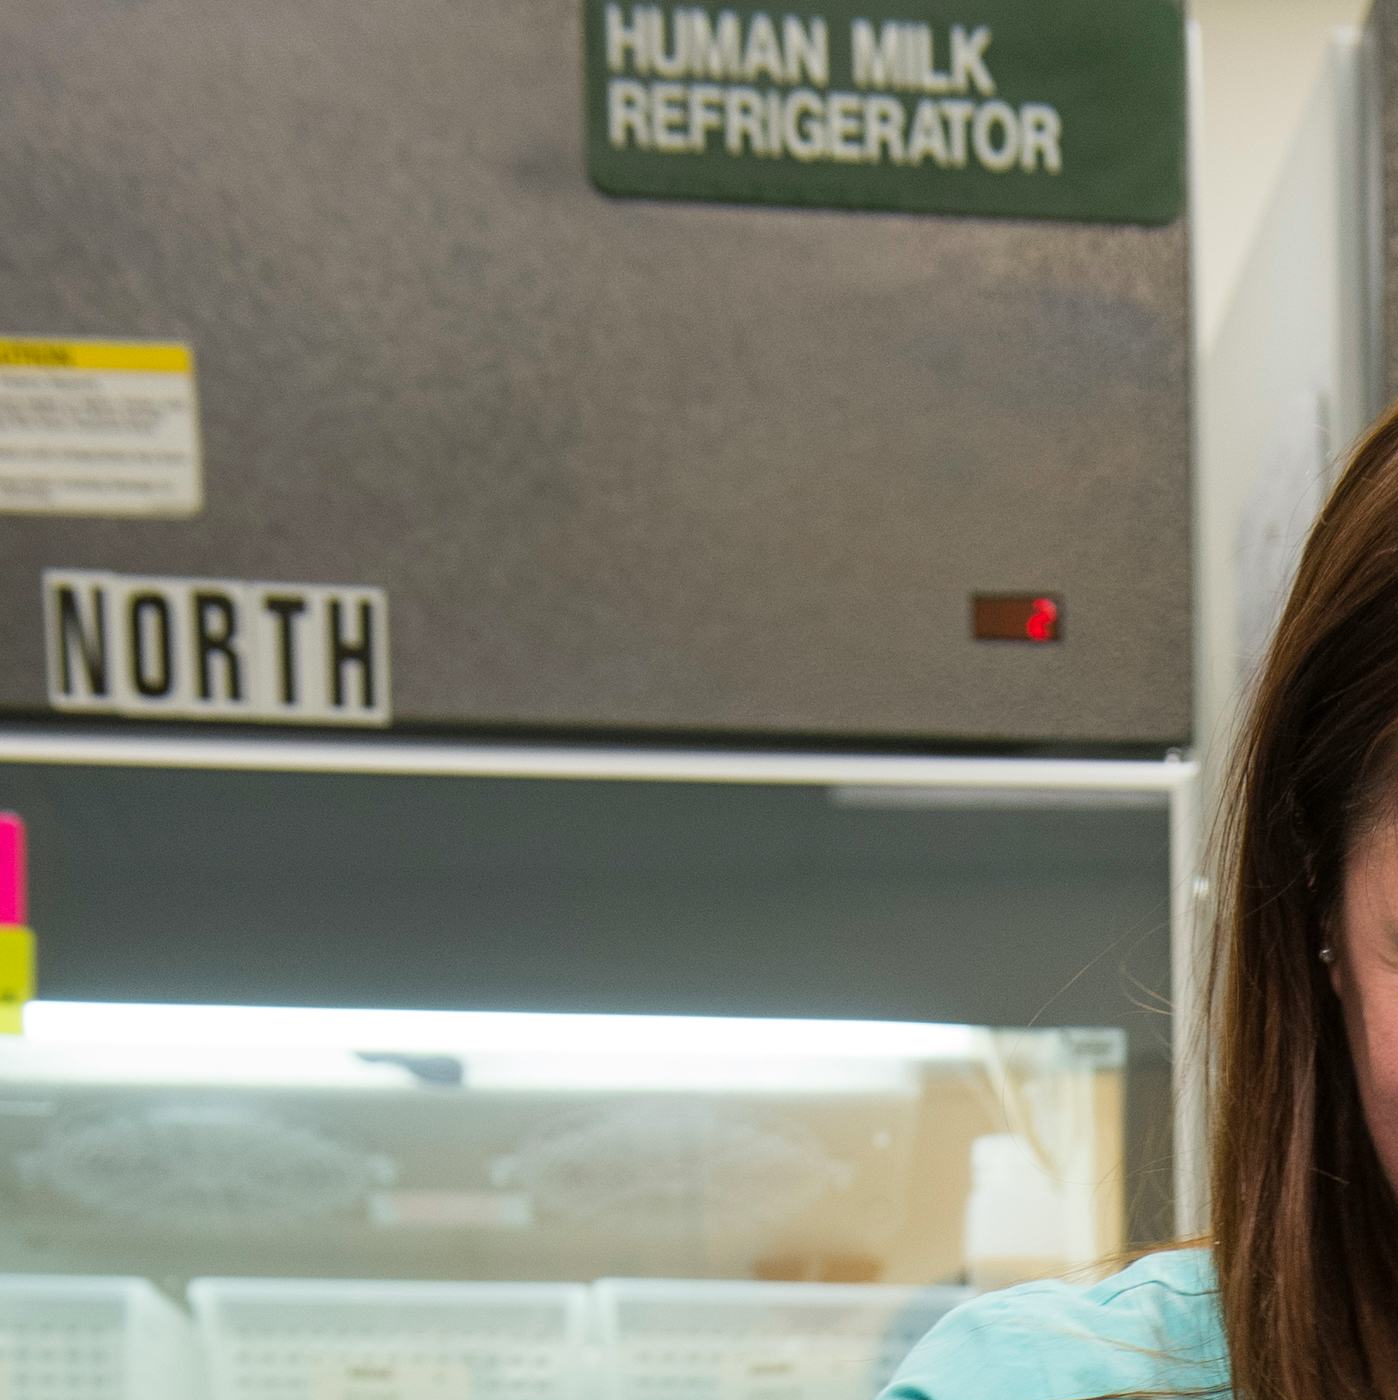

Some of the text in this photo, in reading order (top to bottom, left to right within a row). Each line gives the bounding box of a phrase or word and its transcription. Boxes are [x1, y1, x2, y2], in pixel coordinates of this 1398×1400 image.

[605, 5, 996, 96] HUMAN MILK
[608, 81, 1062, 174] REFRIGERATOR
[56, 583, 377, 710] NORTH
